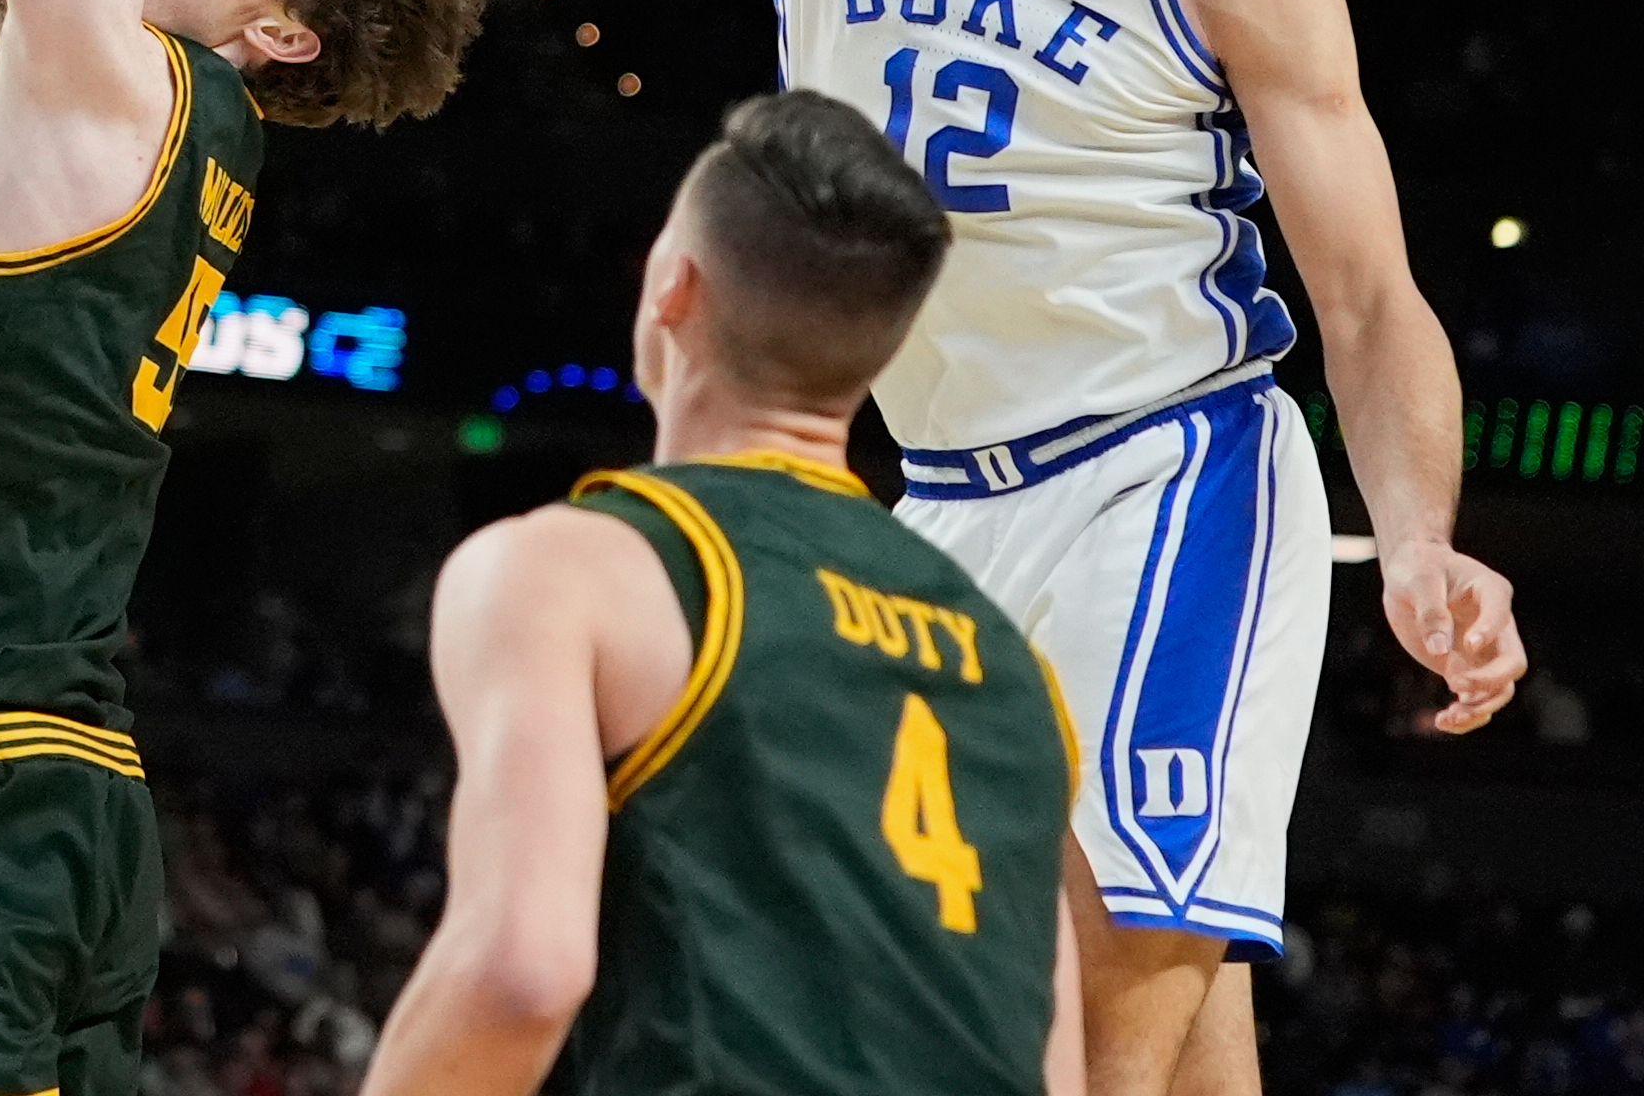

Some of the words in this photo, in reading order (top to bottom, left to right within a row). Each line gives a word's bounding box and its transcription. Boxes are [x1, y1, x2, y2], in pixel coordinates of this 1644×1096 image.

[883, 47, 1020, 212] 12
[971, 444, 1025, 492] D
[880, 692, 984, 935] 4
[1136, 748, 1210, 818] D
